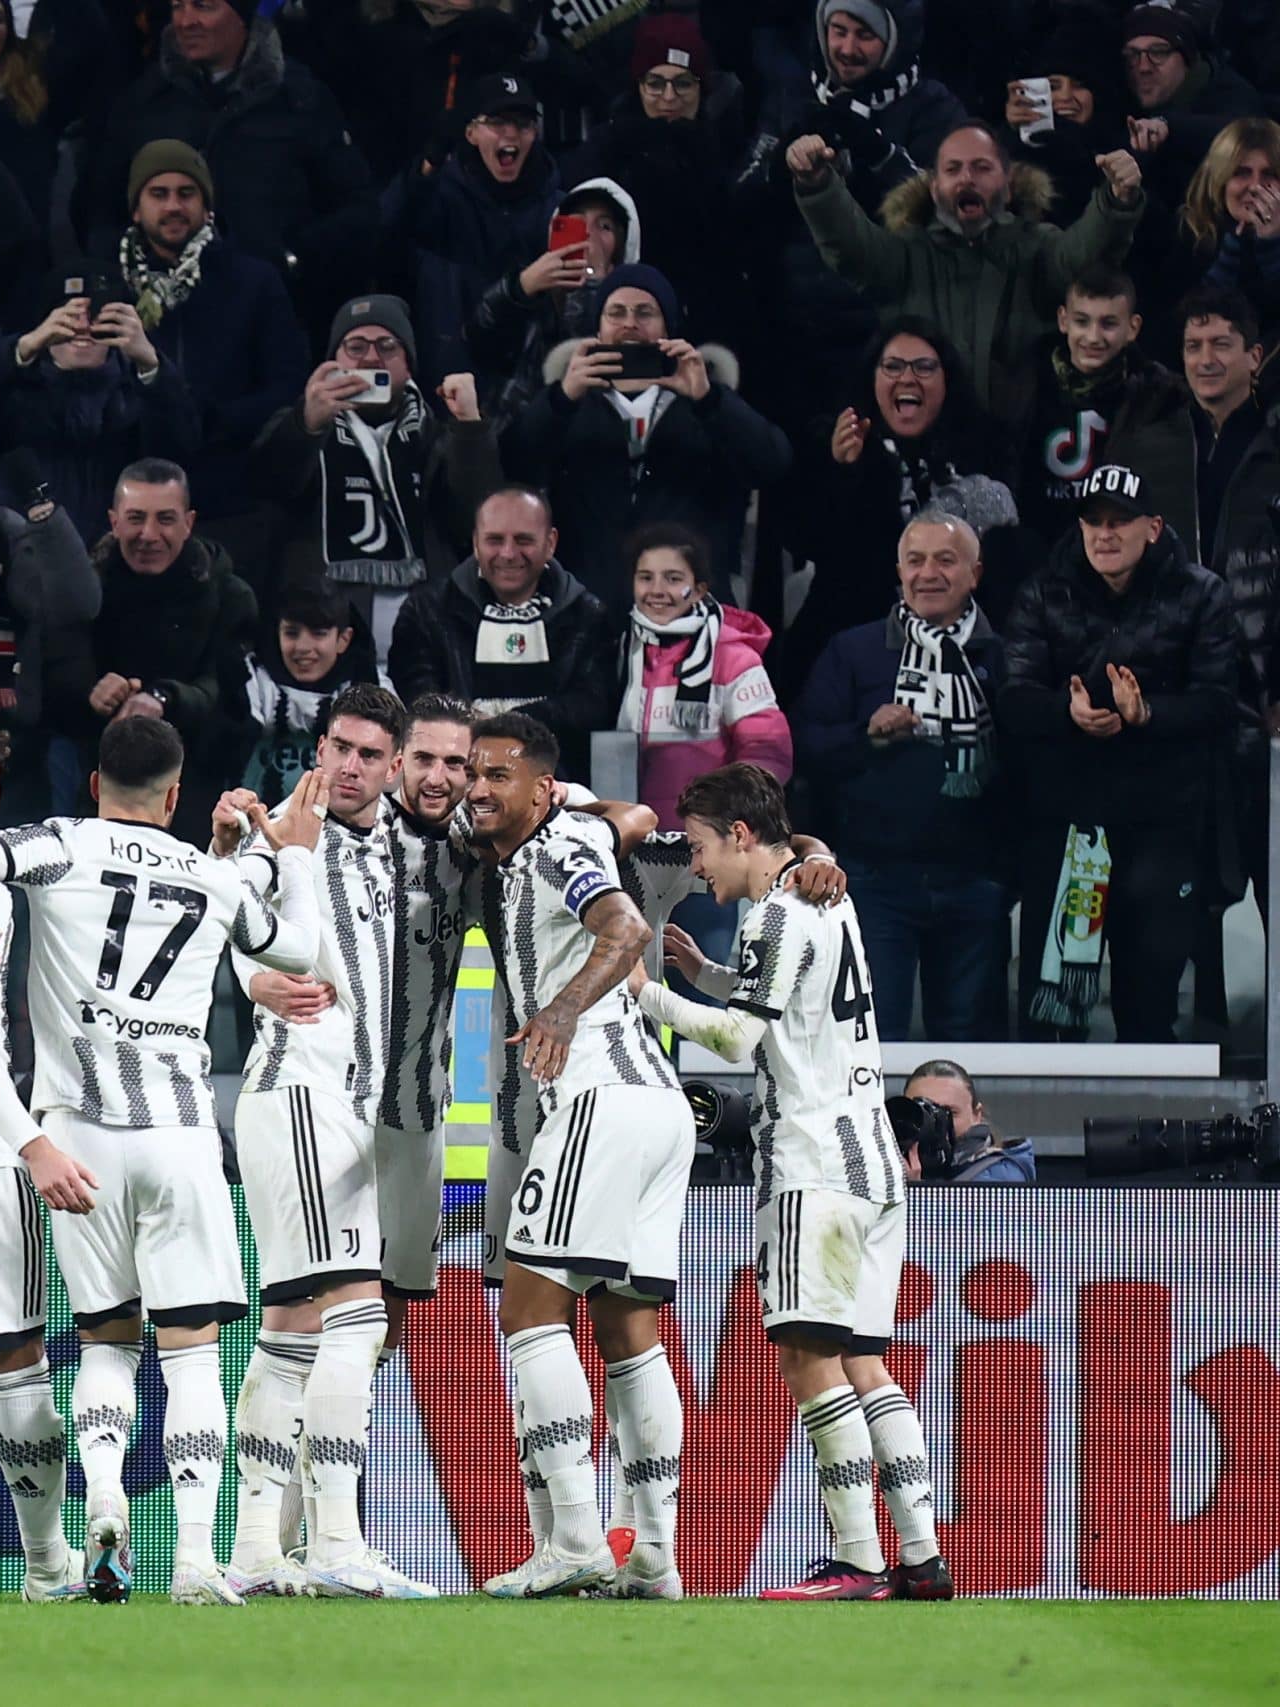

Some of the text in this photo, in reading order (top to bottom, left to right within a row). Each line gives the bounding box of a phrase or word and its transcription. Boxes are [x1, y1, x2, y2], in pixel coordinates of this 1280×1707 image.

[1083, 468, 1140, 499] ICON
[571, 873, 609, 900] PEAC
[96, 869, 208, 1002] 17
[414, 905, 466, 945] Jee
[737, 976, 761, 991] get
[831, 920, 872, 1043] 4
[97, 1008, 202, 1040] Cygames
[518, 1168, 546, 1216] 6
[757, 1241, 770, 1290] 4
